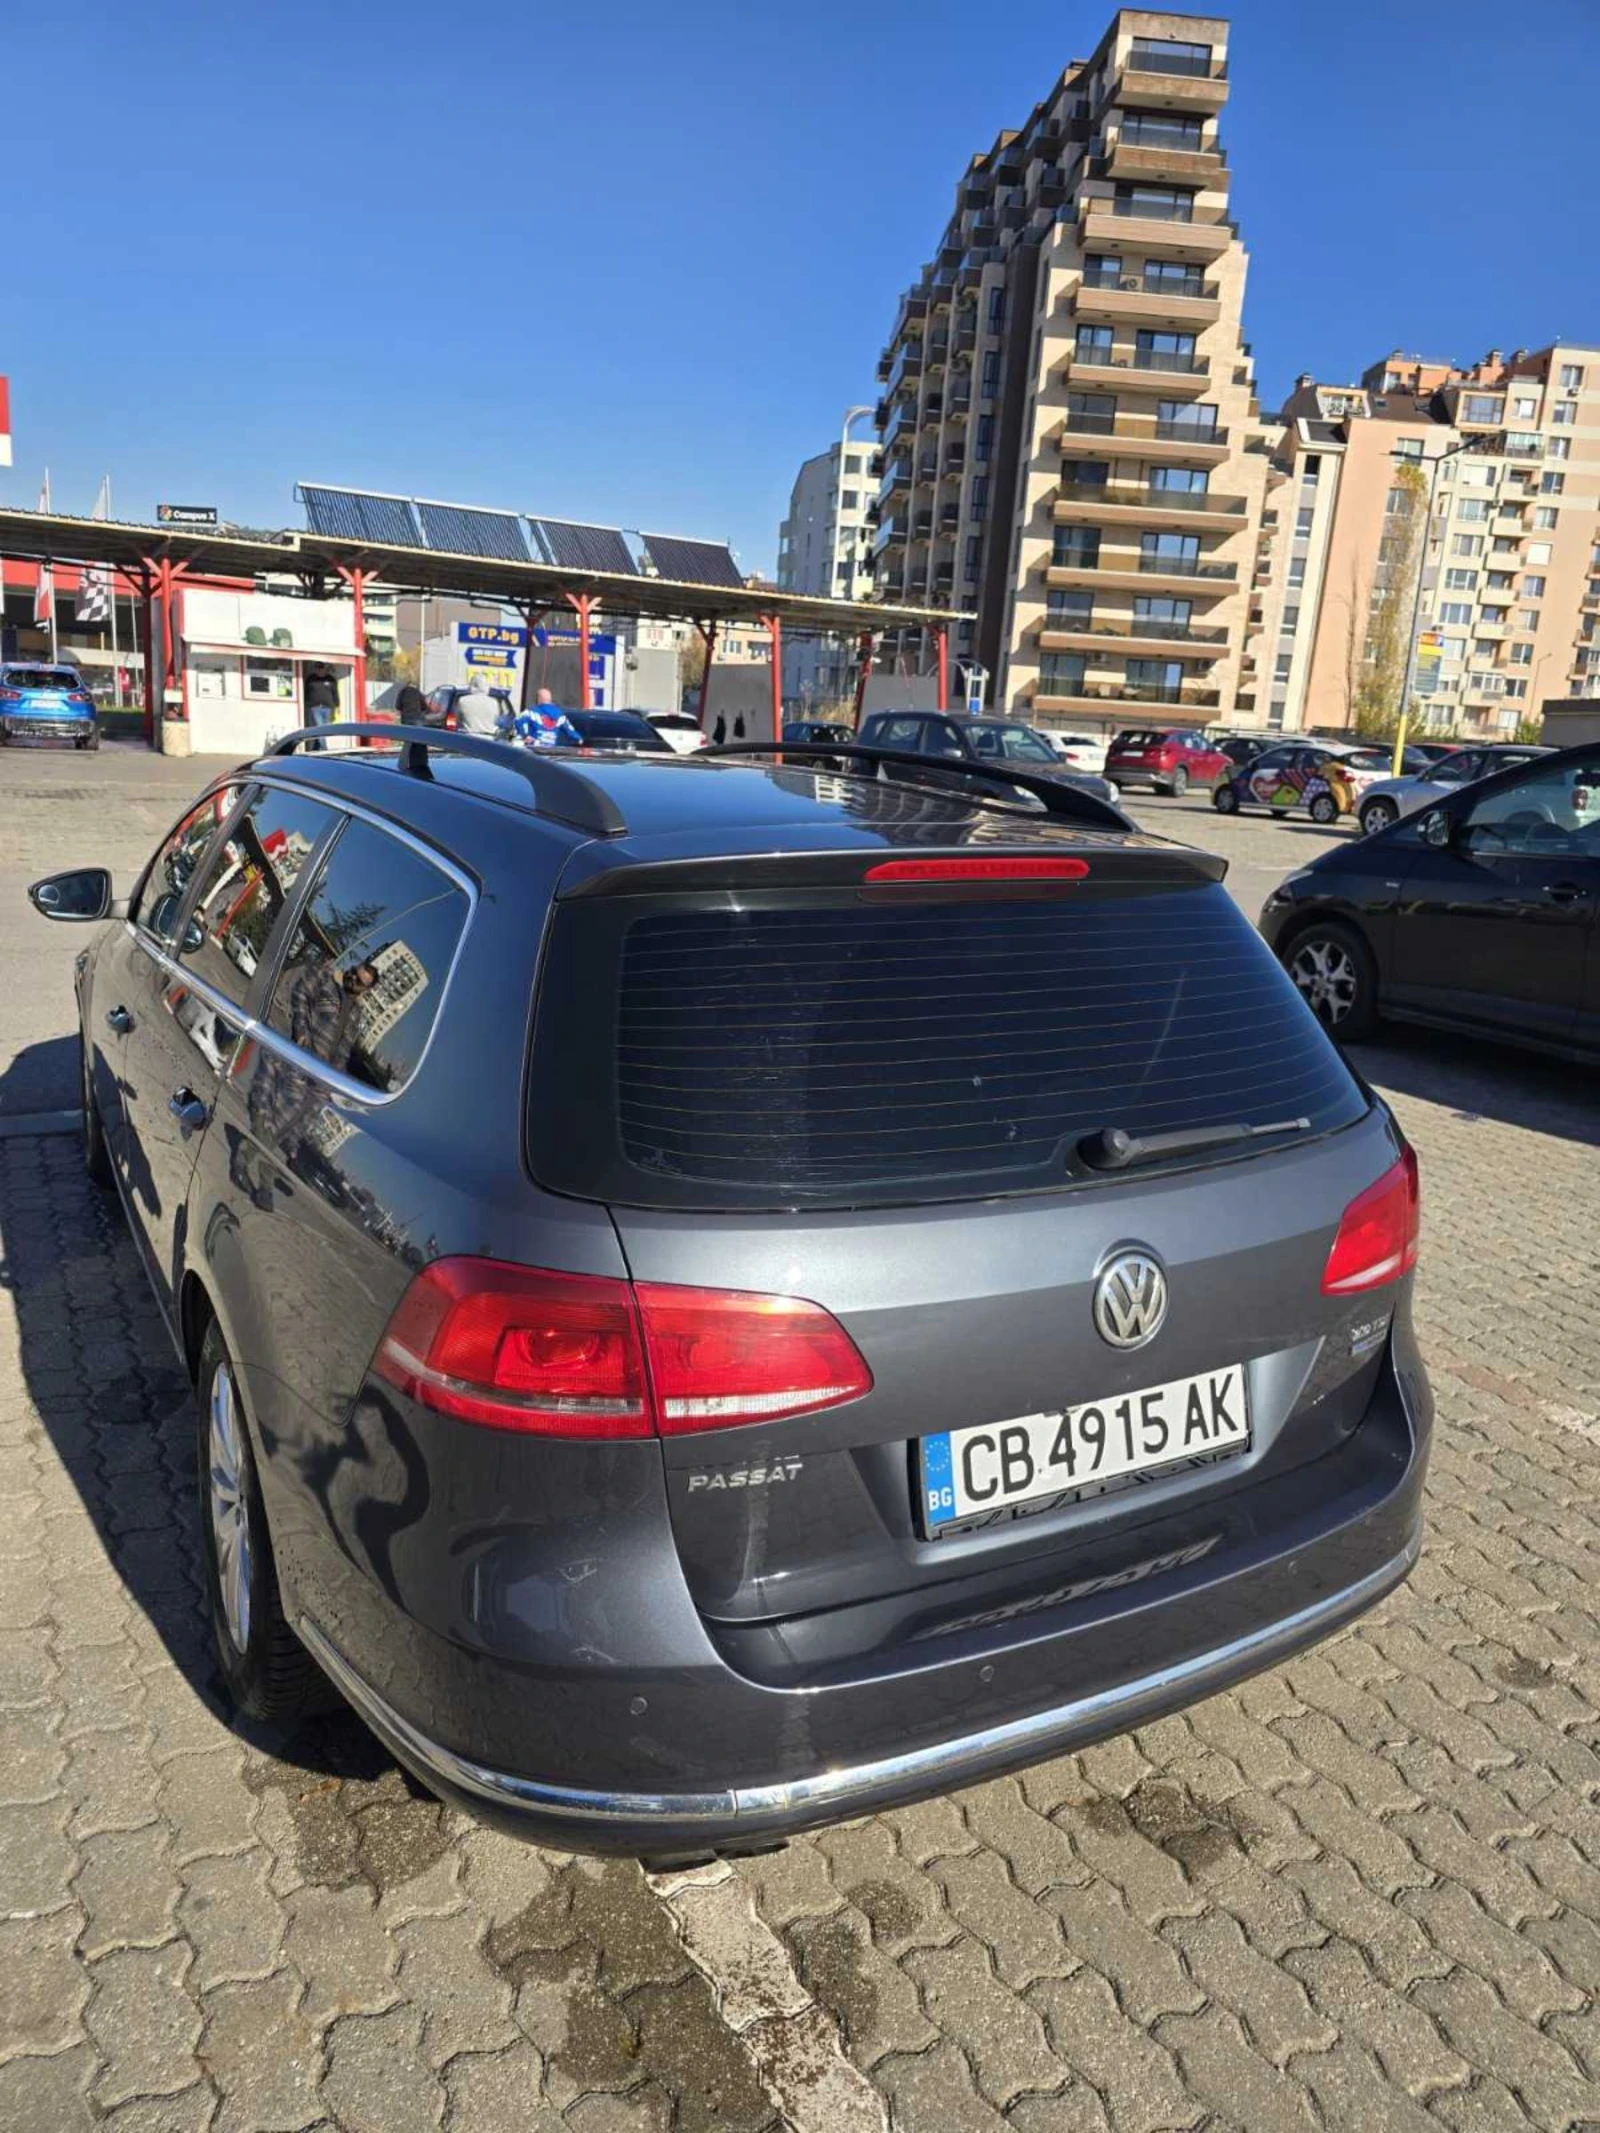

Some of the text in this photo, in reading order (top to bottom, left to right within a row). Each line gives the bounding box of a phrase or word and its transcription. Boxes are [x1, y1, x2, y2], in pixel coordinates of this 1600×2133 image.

[468, 627, 519, 644] GTP.bg
[962, 1373, 1238, 1501] CB 4915 AK
[688, 1463, 803, 1493] PASSAT
[928, 1488, 952, 1511] BG
